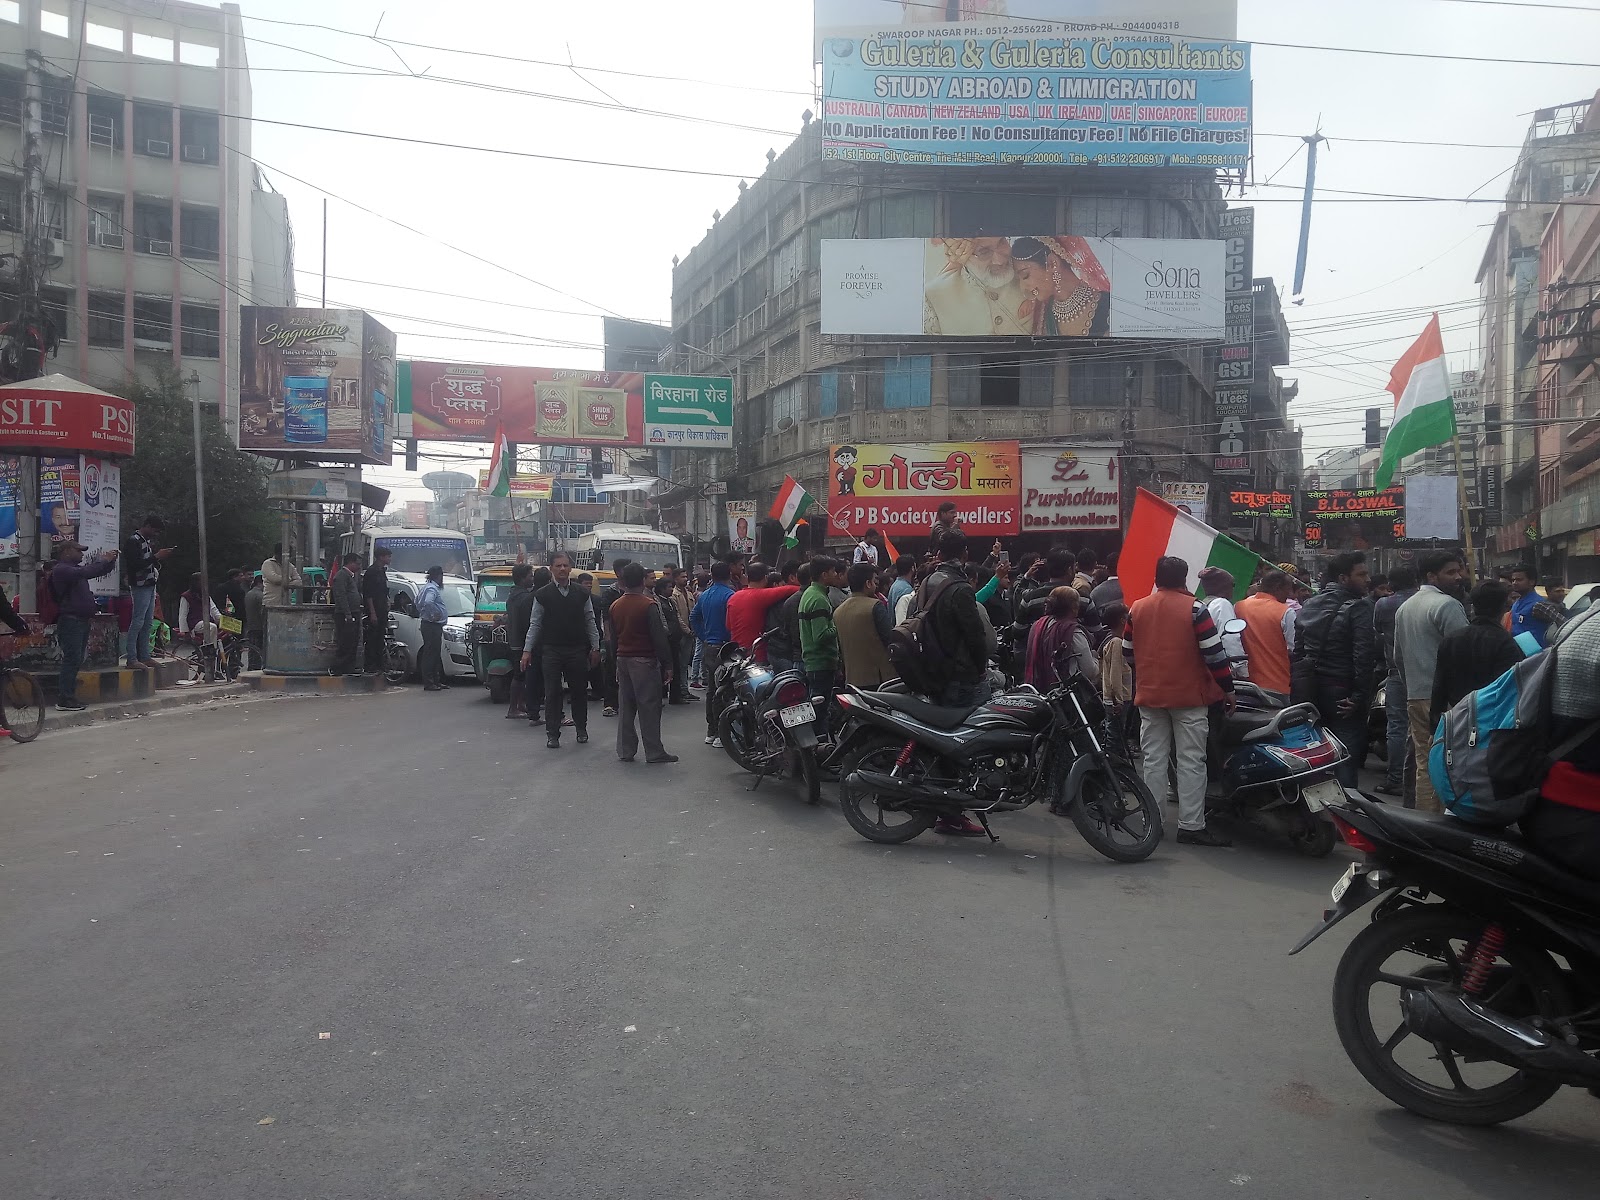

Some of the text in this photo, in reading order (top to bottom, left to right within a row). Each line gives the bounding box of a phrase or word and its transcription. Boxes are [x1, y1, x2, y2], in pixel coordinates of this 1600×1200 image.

[877, 29, 925, 39] SWAROOP
[927, 28, 962, 37] NAGAR
[985, 24, 1053, 35] 0512-2556228
[1122, 21, 1180, 30] 9044004318
[860, 38, 1245, 70] Guleria & Guleria Consultants
[873, 76, 1197, 101] STUDY ABROAD & IMMIGRATION
[824, 101, 1247, 121] AUSTRALIA CANADA NEW ZEALAND USA UK IRELAND UAE SINGAPORE EUROPE
[844, 123, 929, 140] Application
[971, 126, 991, 141] No
[993, 126, 1087, 143] Consultancy
[1129, 127, 1149, 141] No
[1151, 127, 1179, 142] File
[1180, 127, 1249, 144] Charges!
[843, 148, 856, 160] 1st
[859, 149, 882, 162] Floor,
[884, 150, 901, 163] City
[903, 151, 934, 163] Centre,
[845, 272, 879, 280] PROMISE
[1144, 259, 1202, 289] Sona
[840, 281, 883, 290] FOREVER
[1144, 290, 1201, 301] JEWELLERS
[1225, 299, 1251, 314] Tees
[1218, 360, 1252, 378] GST
[650, 381, 728, 403] बिरहाना रोड
[443, 397, 489, 413] प्लस
[594, 413, 608, 421] PLUS
[862, 450, 1013, 491] गोल्डी मसाले
[1024, 486, 1119, 508] Purshottam
[1230, 491, 1258, 508] राजू
[1346, 495, 1396, 510] OSWAL
[881, 506, 938, 528] Society
[1024, 512, 1118, 527] Das Jewellers
